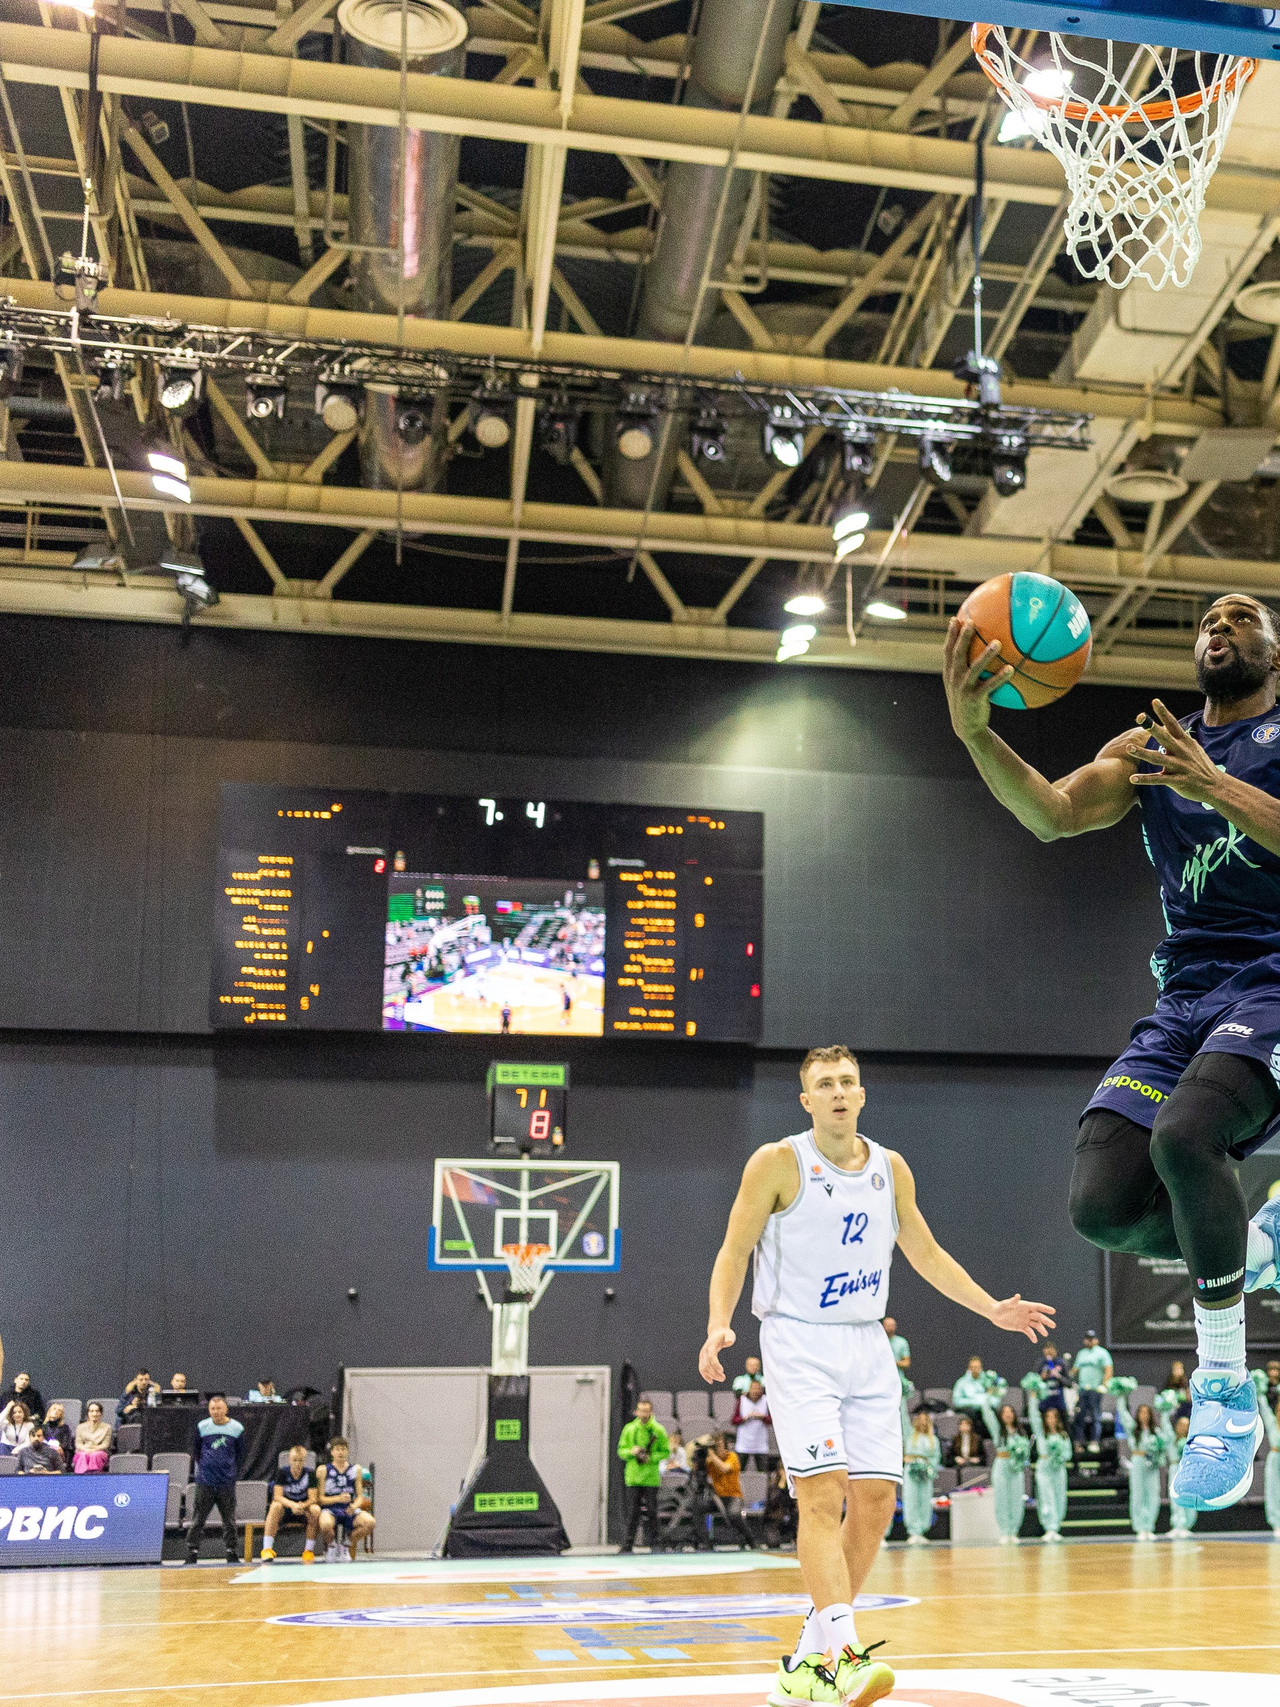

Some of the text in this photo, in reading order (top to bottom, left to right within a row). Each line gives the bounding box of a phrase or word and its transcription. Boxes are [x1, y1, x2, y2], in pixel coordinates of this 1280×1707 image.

[529, 1109, 551, 1139] 8
[841, 1212, 869, 1245] 12
[819, 1268, 883, 1309] Enisey
